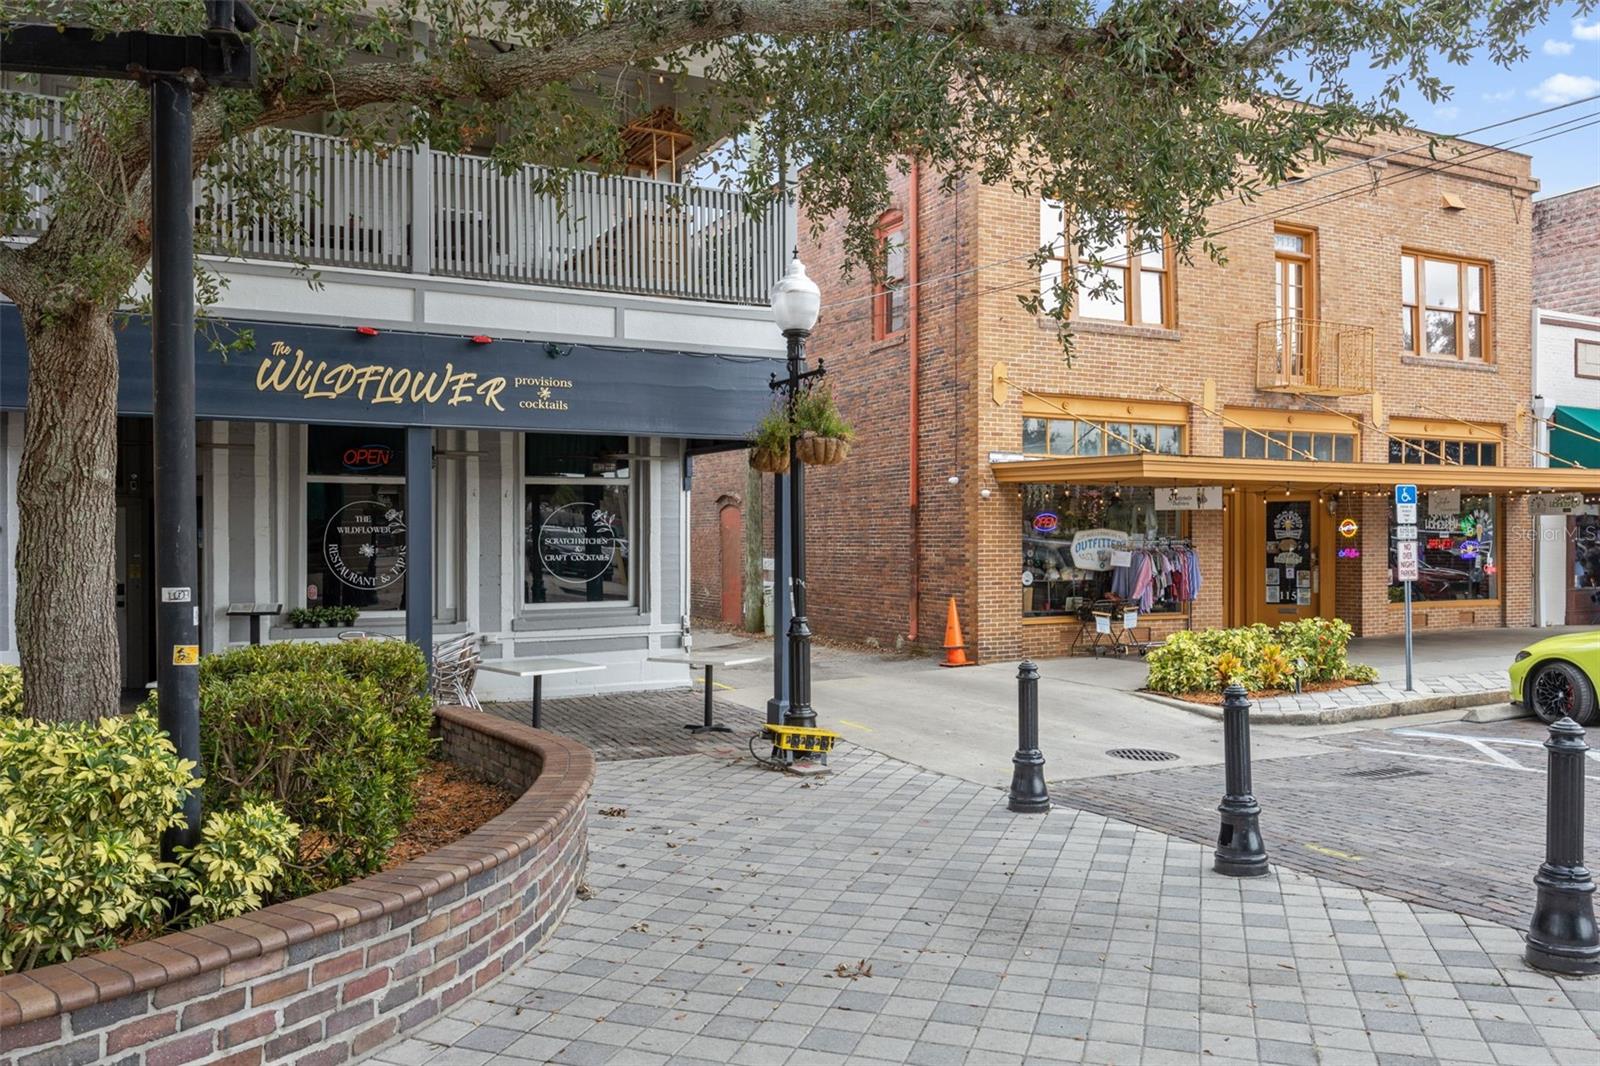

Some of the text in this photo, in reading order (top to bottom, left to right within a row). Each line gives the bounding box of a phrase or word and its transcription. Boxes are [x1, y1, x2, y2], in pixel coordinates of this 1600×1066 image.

[271, 341, 292, 357] The
[514, 375, 573, 389] provisions
[519, 398, 569, 411] cocktails
[343, 447, 391, 466] OPEN
[354, 515, 372, 523] THE
[1033, 516, 1057, 528] OPEN
[336, 526, 391, 534] WILDFLOWER
[567, 526, 588, 534] LATIN
[544, 537, 608, 545] SCRATCH KITCHEN
[1403, 543, 1412, 551] NO
[570, 554, 610, 562] COCKTAILS
[328, 543, 377, 587] RESTAURANT
[380, 573, 391, 583] &
[1400, 560, 1415, 569] NIGHT
[1280, 591, 1297, 601] 115
